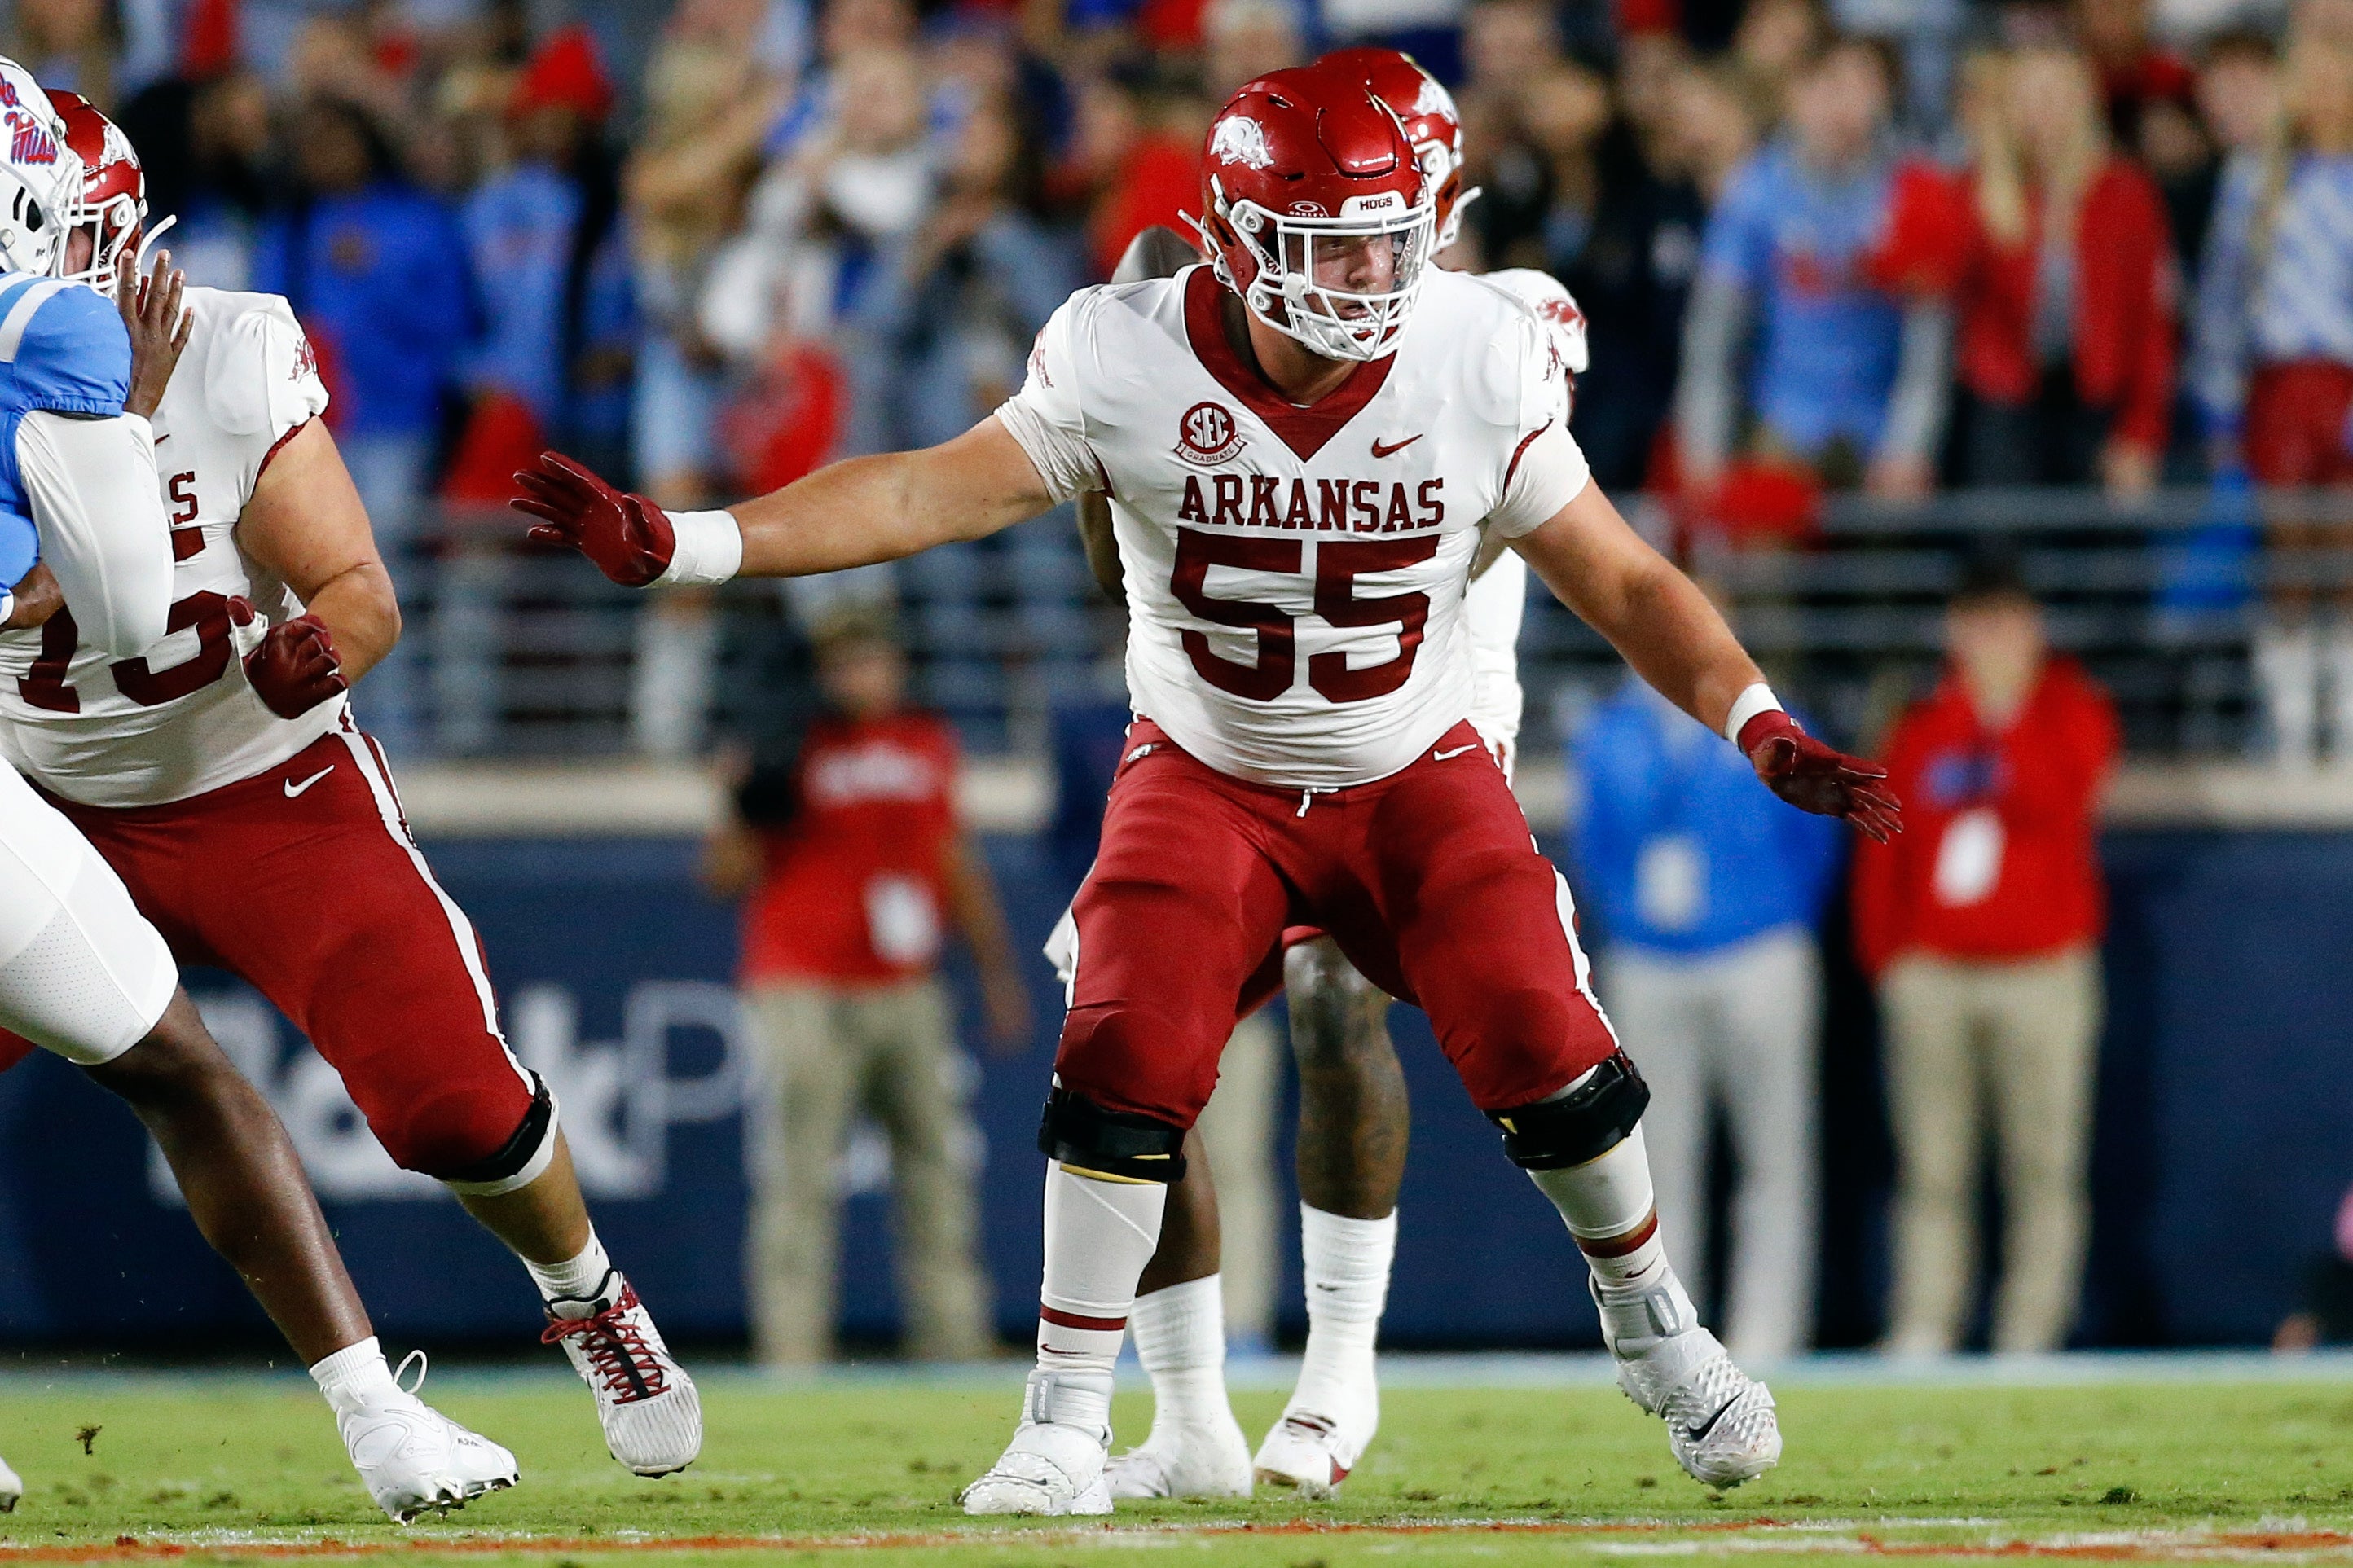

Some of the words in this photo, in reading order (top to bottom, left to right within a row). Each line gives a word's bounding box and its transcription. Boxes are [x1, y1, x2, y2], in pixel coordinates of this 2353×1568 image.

[1359, 196, 1392, 211] HOGS
[1187, 407, 1229, 448] SEC
[1187, 447, 1234, 463] GRADUATE
[1178, 473, 1445, 533] ARKANSAS
[1170, 526, 1441, 703] 55
